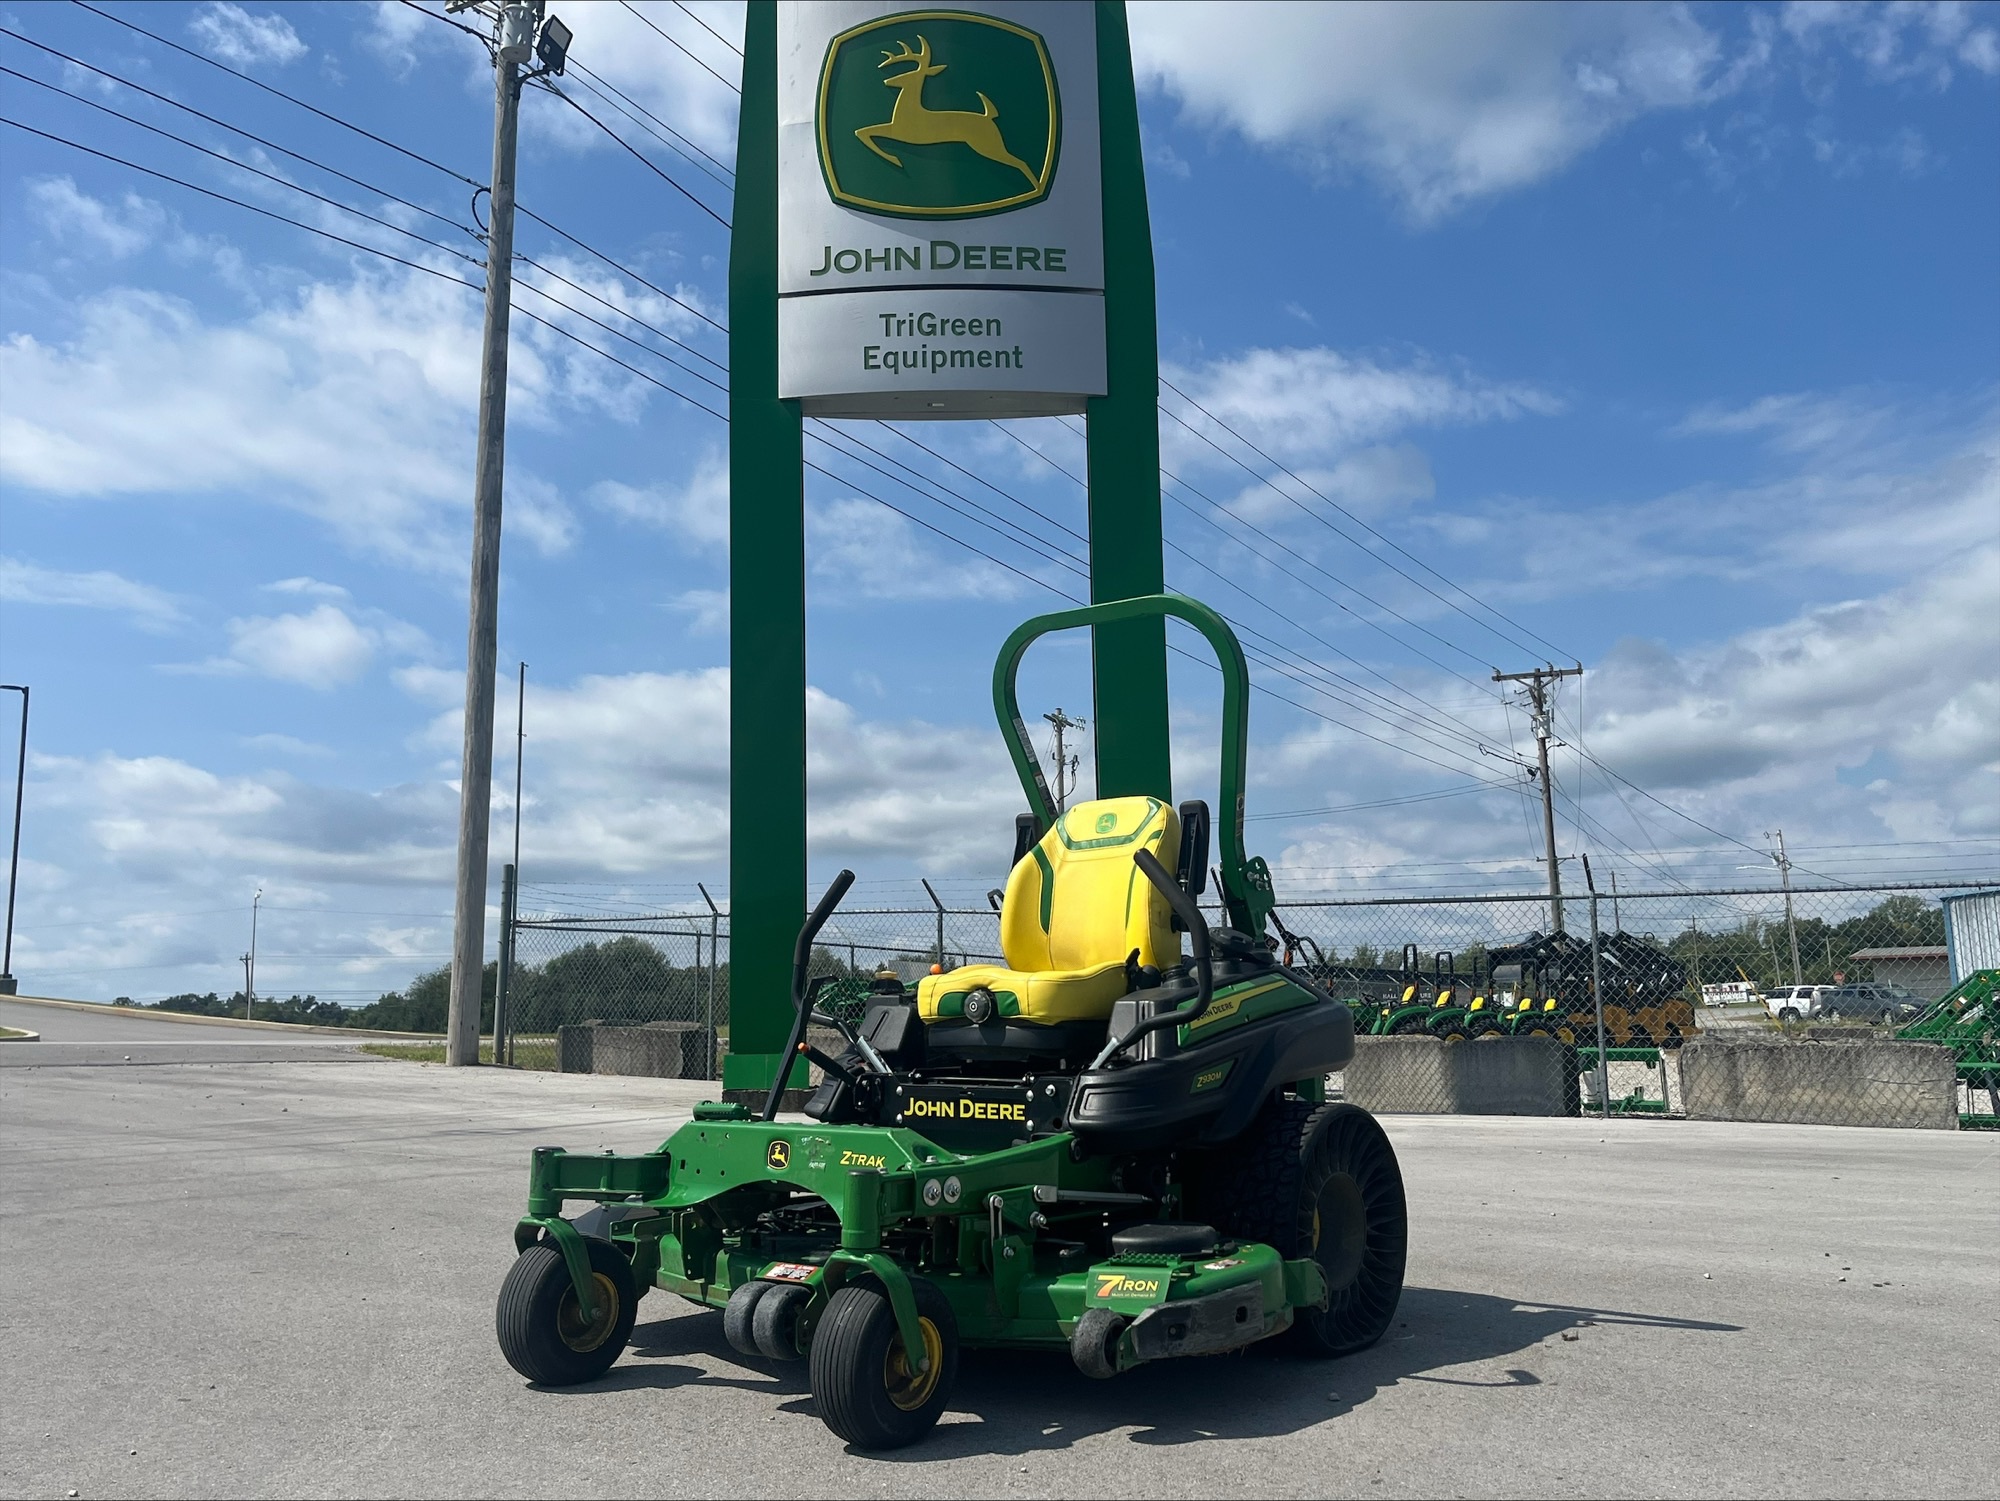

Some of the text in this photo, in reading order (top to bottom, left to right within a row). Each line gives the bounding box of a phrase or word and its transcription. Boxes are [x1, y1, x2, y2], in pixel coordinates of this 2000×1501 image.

[810, 240, 1067, 276] JOHN DEERE
[879, 312, 1001, 338] TriGreen
[863, 344, 1023, 375] Equipment
[1212, 1001, 1234, 1015] DEERE
[1196, 1071, 1222, 1088] Z930M
[903, 1097, 1026, 1121] JOHN DEERE
[840, 1150, 886, 1168] ZTRAK
